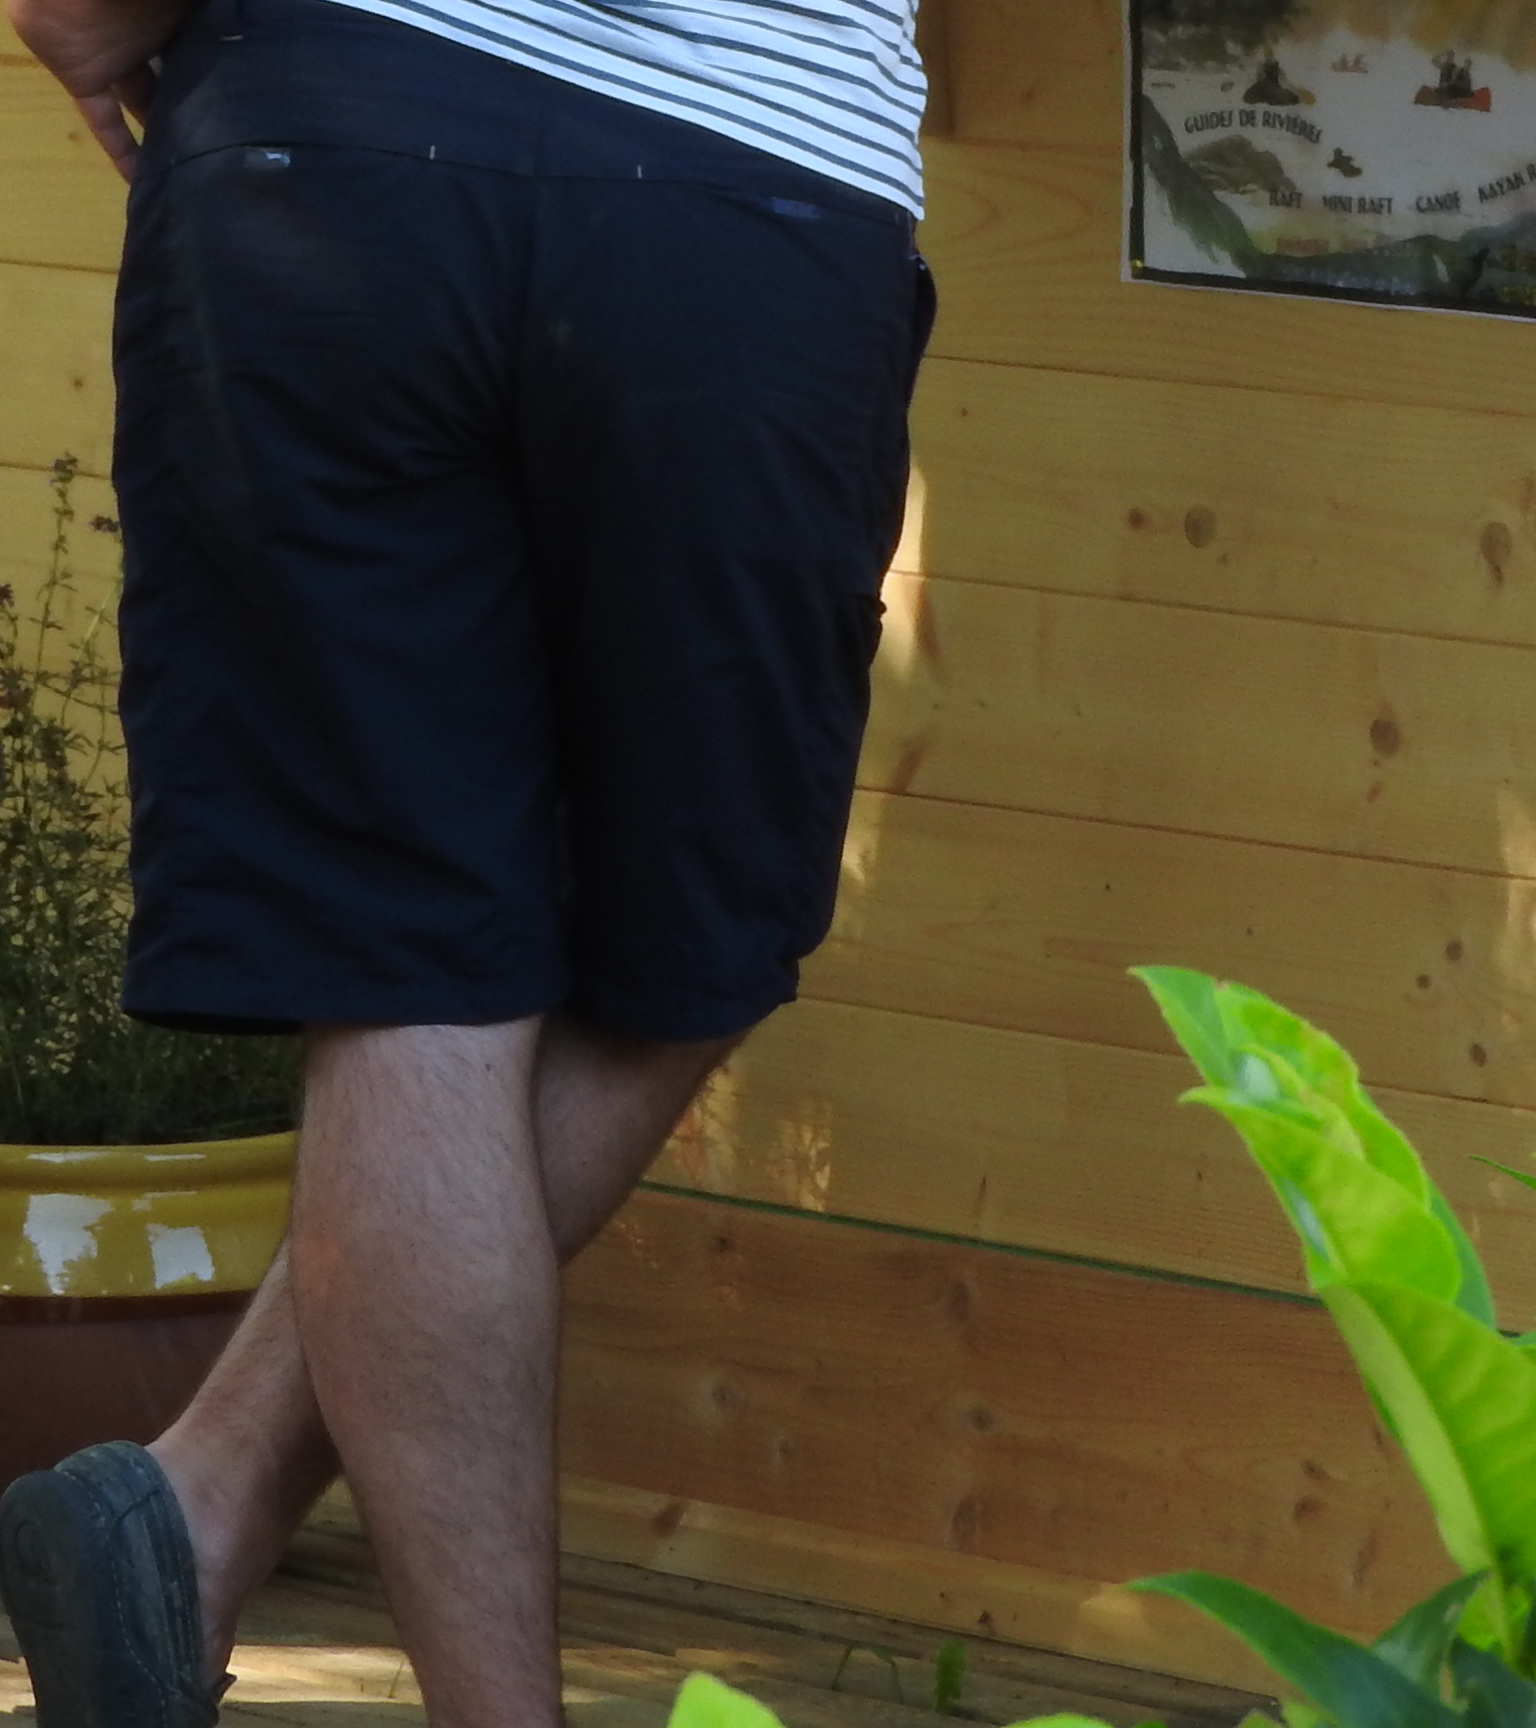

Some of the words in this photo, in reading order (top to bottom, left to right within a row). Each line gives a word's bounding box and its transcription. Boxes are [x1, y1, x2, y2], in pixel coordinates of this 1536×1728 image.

[1184, 109, 1233, 134] GUIDES
[1238, 108, 1258, 127] DE
[1269, 190, 1303, 210] RAFT
[1356, 197, 1394, 215] RAFT
[1415, 190, 1462, 214] CANOE
